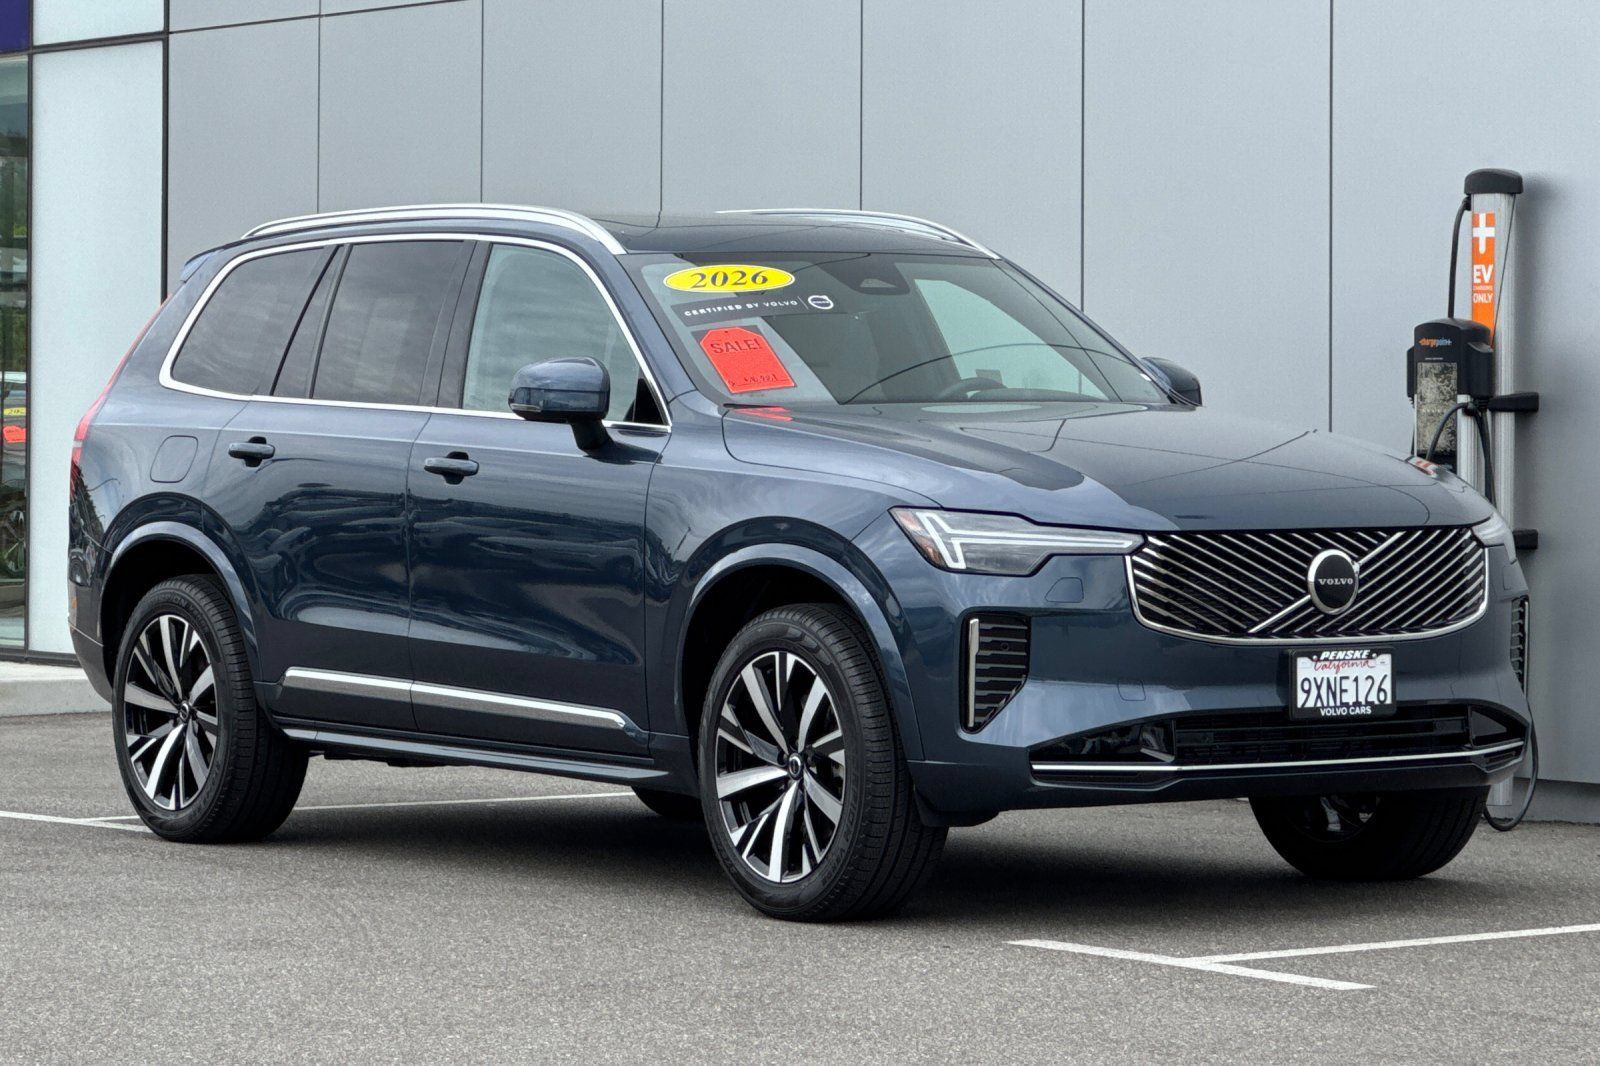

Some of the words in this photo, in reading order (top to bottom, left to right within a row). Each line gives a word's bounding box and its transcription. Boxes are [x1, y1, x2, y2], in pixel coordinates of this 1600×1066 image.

[690, 270, 769, 289] 2026
[1473, 264, 1494, 284] EV
[1473, 292, 1494, 304] ONLY
[684, 304, 743, 316] CERTIFIED
[710, 338, 763, 355] SALE!
[1318, 577, 1354, 586] VOLVO
[1320, 650, 1371, 661] PENSKE
[1313, 660, 1377, 674] California
[1300, 674, 1388, 709] 9XNE126
[1319, 707, 1347, 717] VOLVO
[1348, 705, 1372, 715] CARS
